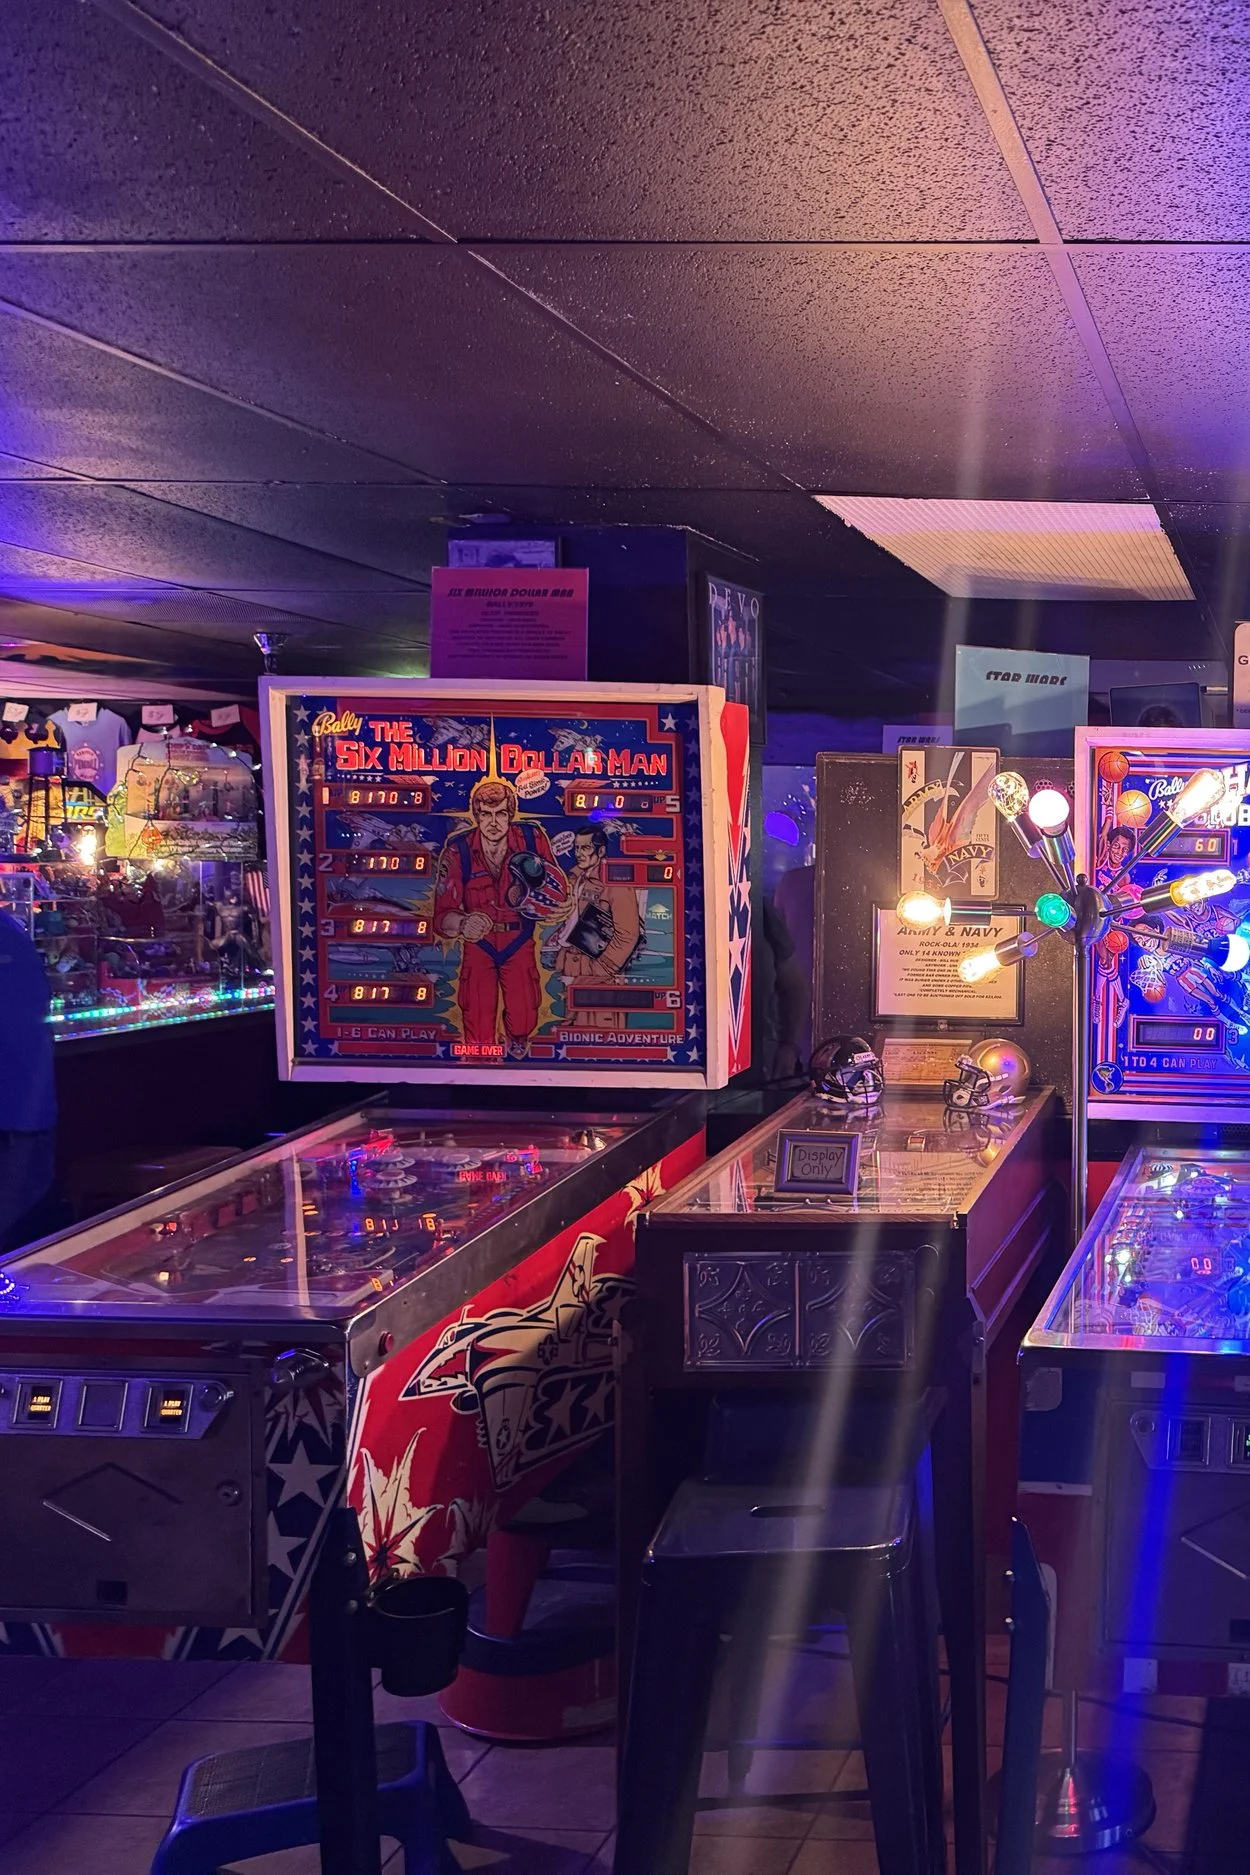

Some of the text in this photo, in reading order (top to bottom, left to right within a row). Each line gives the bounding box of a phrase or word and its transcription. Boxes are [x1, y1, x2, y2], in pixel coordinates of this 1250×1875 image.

[464, 588, 507, 597] MILLION
[509, 588, 548, 597] DOLLAR
[550, 588, 574, 597] MAN
[709, 582, 759, 619] DEVO
[1025, 673, 1067, 685] WARS
[312, 710, 364, 736] Bally
[368, 721, 414, 742] THE
[918, 736, 940, 744] WARS
[500, 743, 603, 774] DOLLAR
[607, 748, 667, 777] MAN
[1149, 776, 1188, 800] Ball
[665, 795, 681, 812] 5
[318, 853, 333, 871] 2
[948, 846, 992, 866] NAVY
[320, 920, 335, 936] 3
[945, 926, 955, 937] &
[960, 926, 1004, 937] NAVY
[324, 984, 339, 1001] 4
[667, 991, 682, 1008] 6
[337, 1027, 436, 1040] 1-6 CAN PLAY
[559, 1032, 684, 1044] BIONIC ADVENTURE
[1227, 1029, 1239, 1046] 3
[454, 1044, 503, 1056] GAME OVER
[1131, 1056, 1145, 1067] TO
[1149, 1056, 1157, 1068] 4
[1162, 1056, 1186, 1069] CAN
[1190, 1058, 1217, 1069] PLAY
[796, 1149, 844, 1166] Display
[800, 1163, 834, 1178] Only
